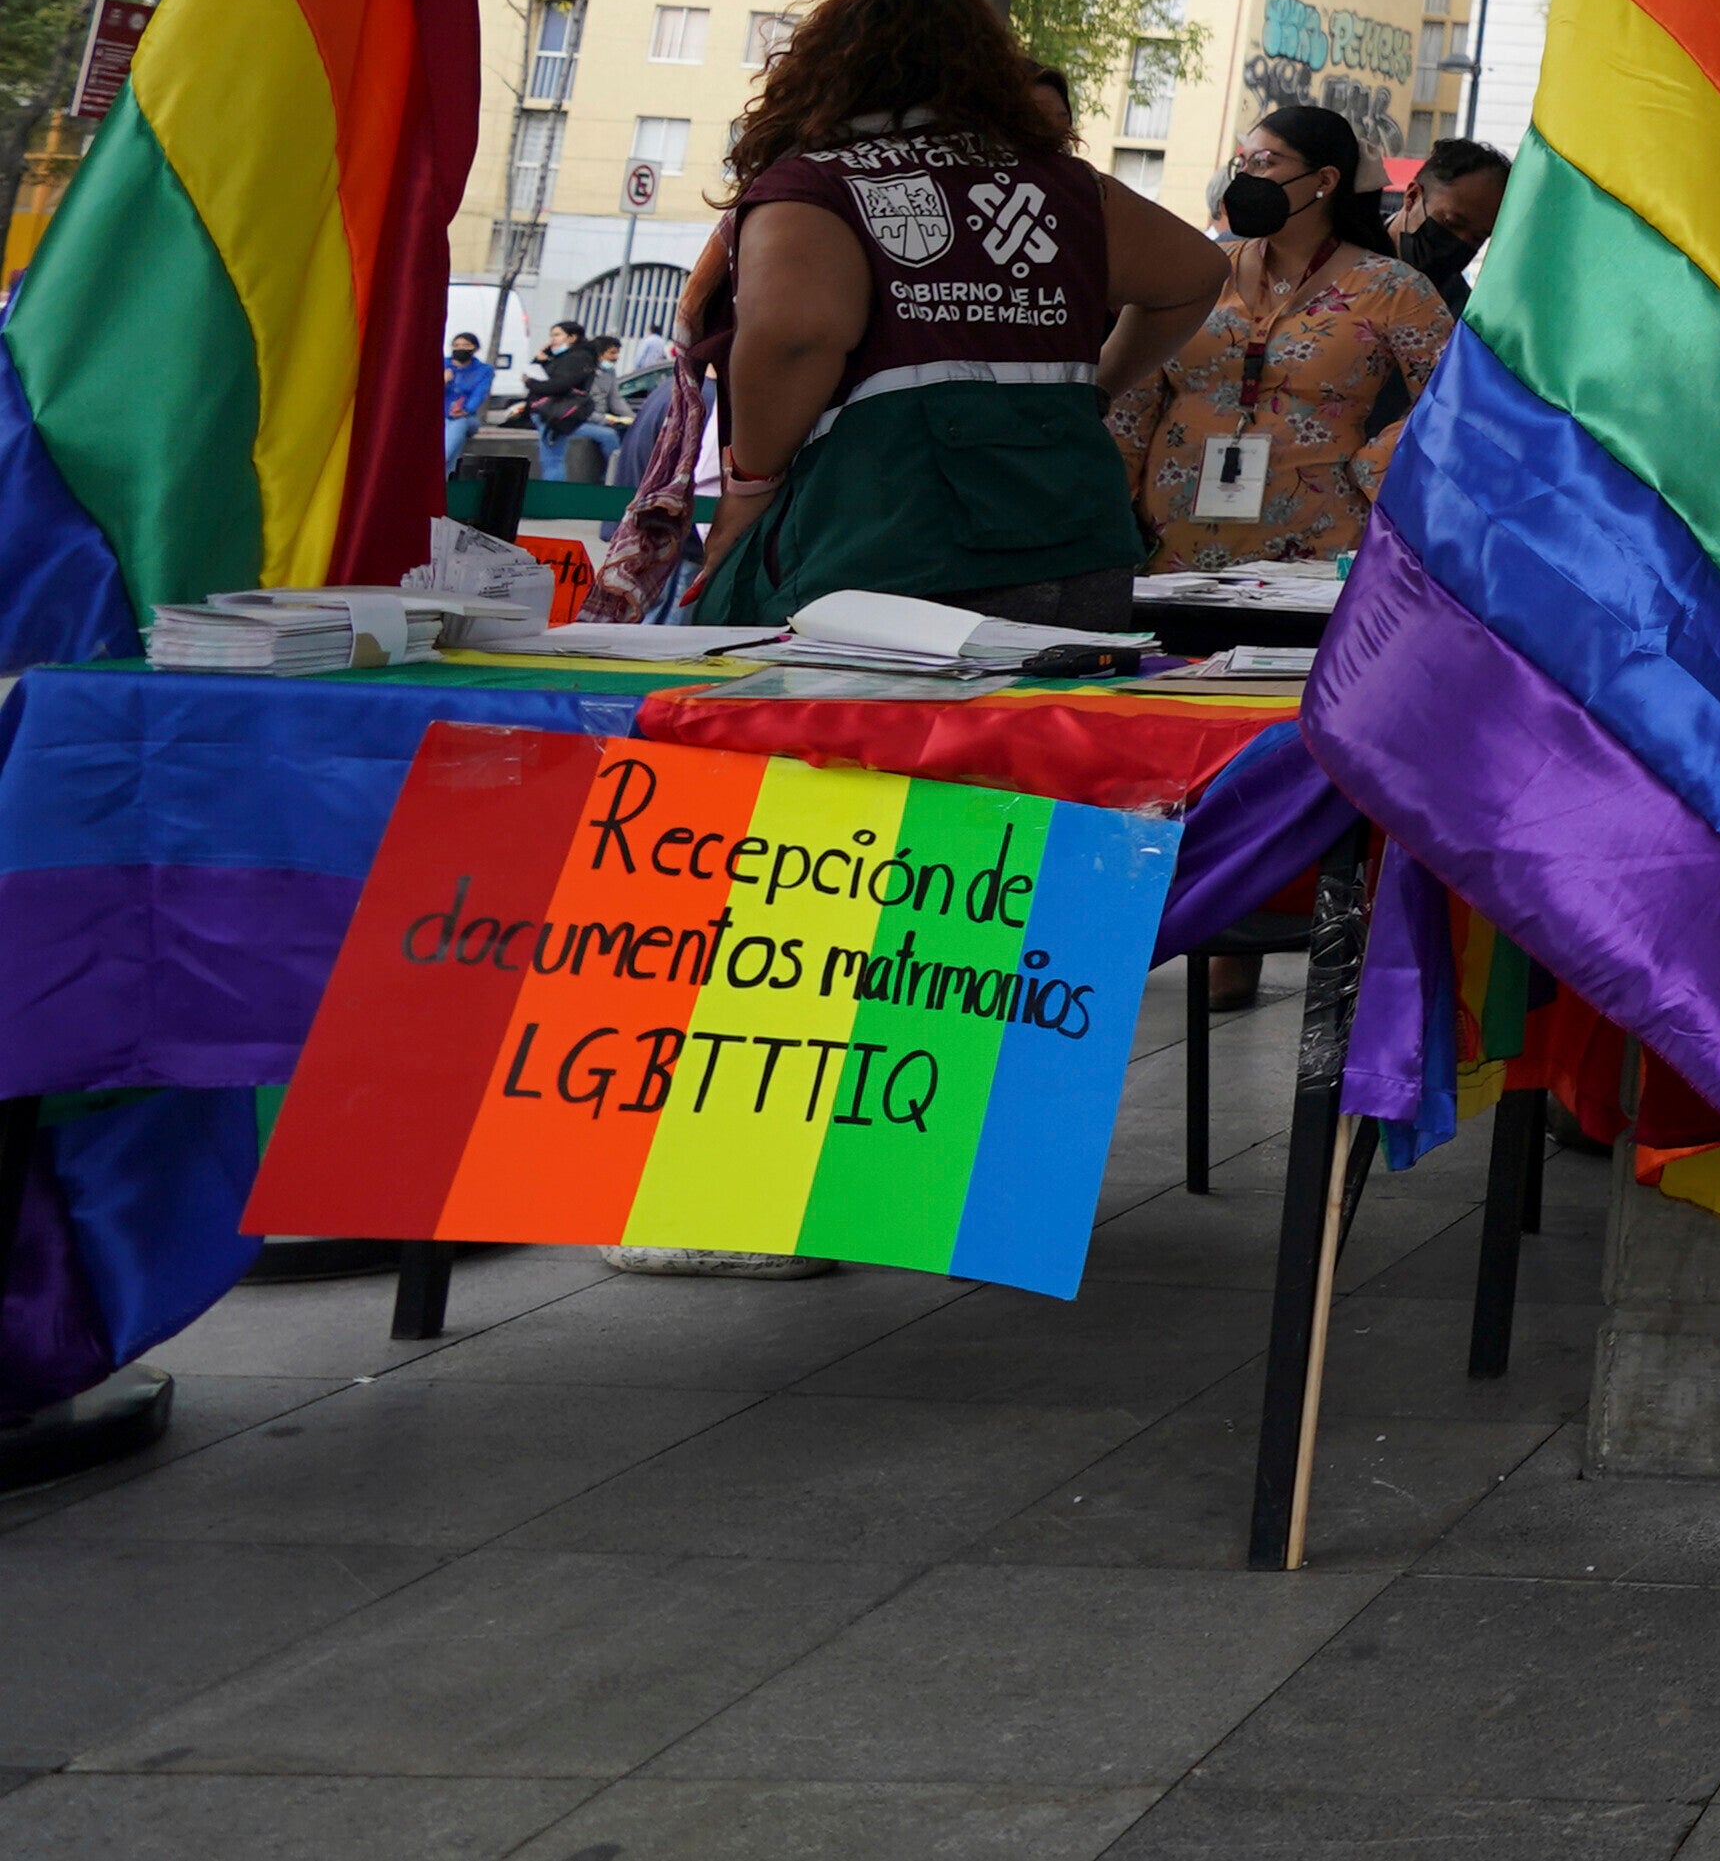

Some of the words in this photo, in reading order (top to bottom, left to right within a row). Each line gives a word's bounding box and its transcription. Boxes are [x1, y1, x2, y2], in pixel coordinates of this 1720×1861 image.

[966, 304, 996, 322] DE
[1038, 286, 1066, 306] LA
[590, 759, 954, 916] Recepción
[967, 823, 1035, 930] de
[399, 875, 803, 991] documentos
[819, 929, 1095, 1041] matrimonios
[503, 1021, 940, 1134] LGBTTTIQ
